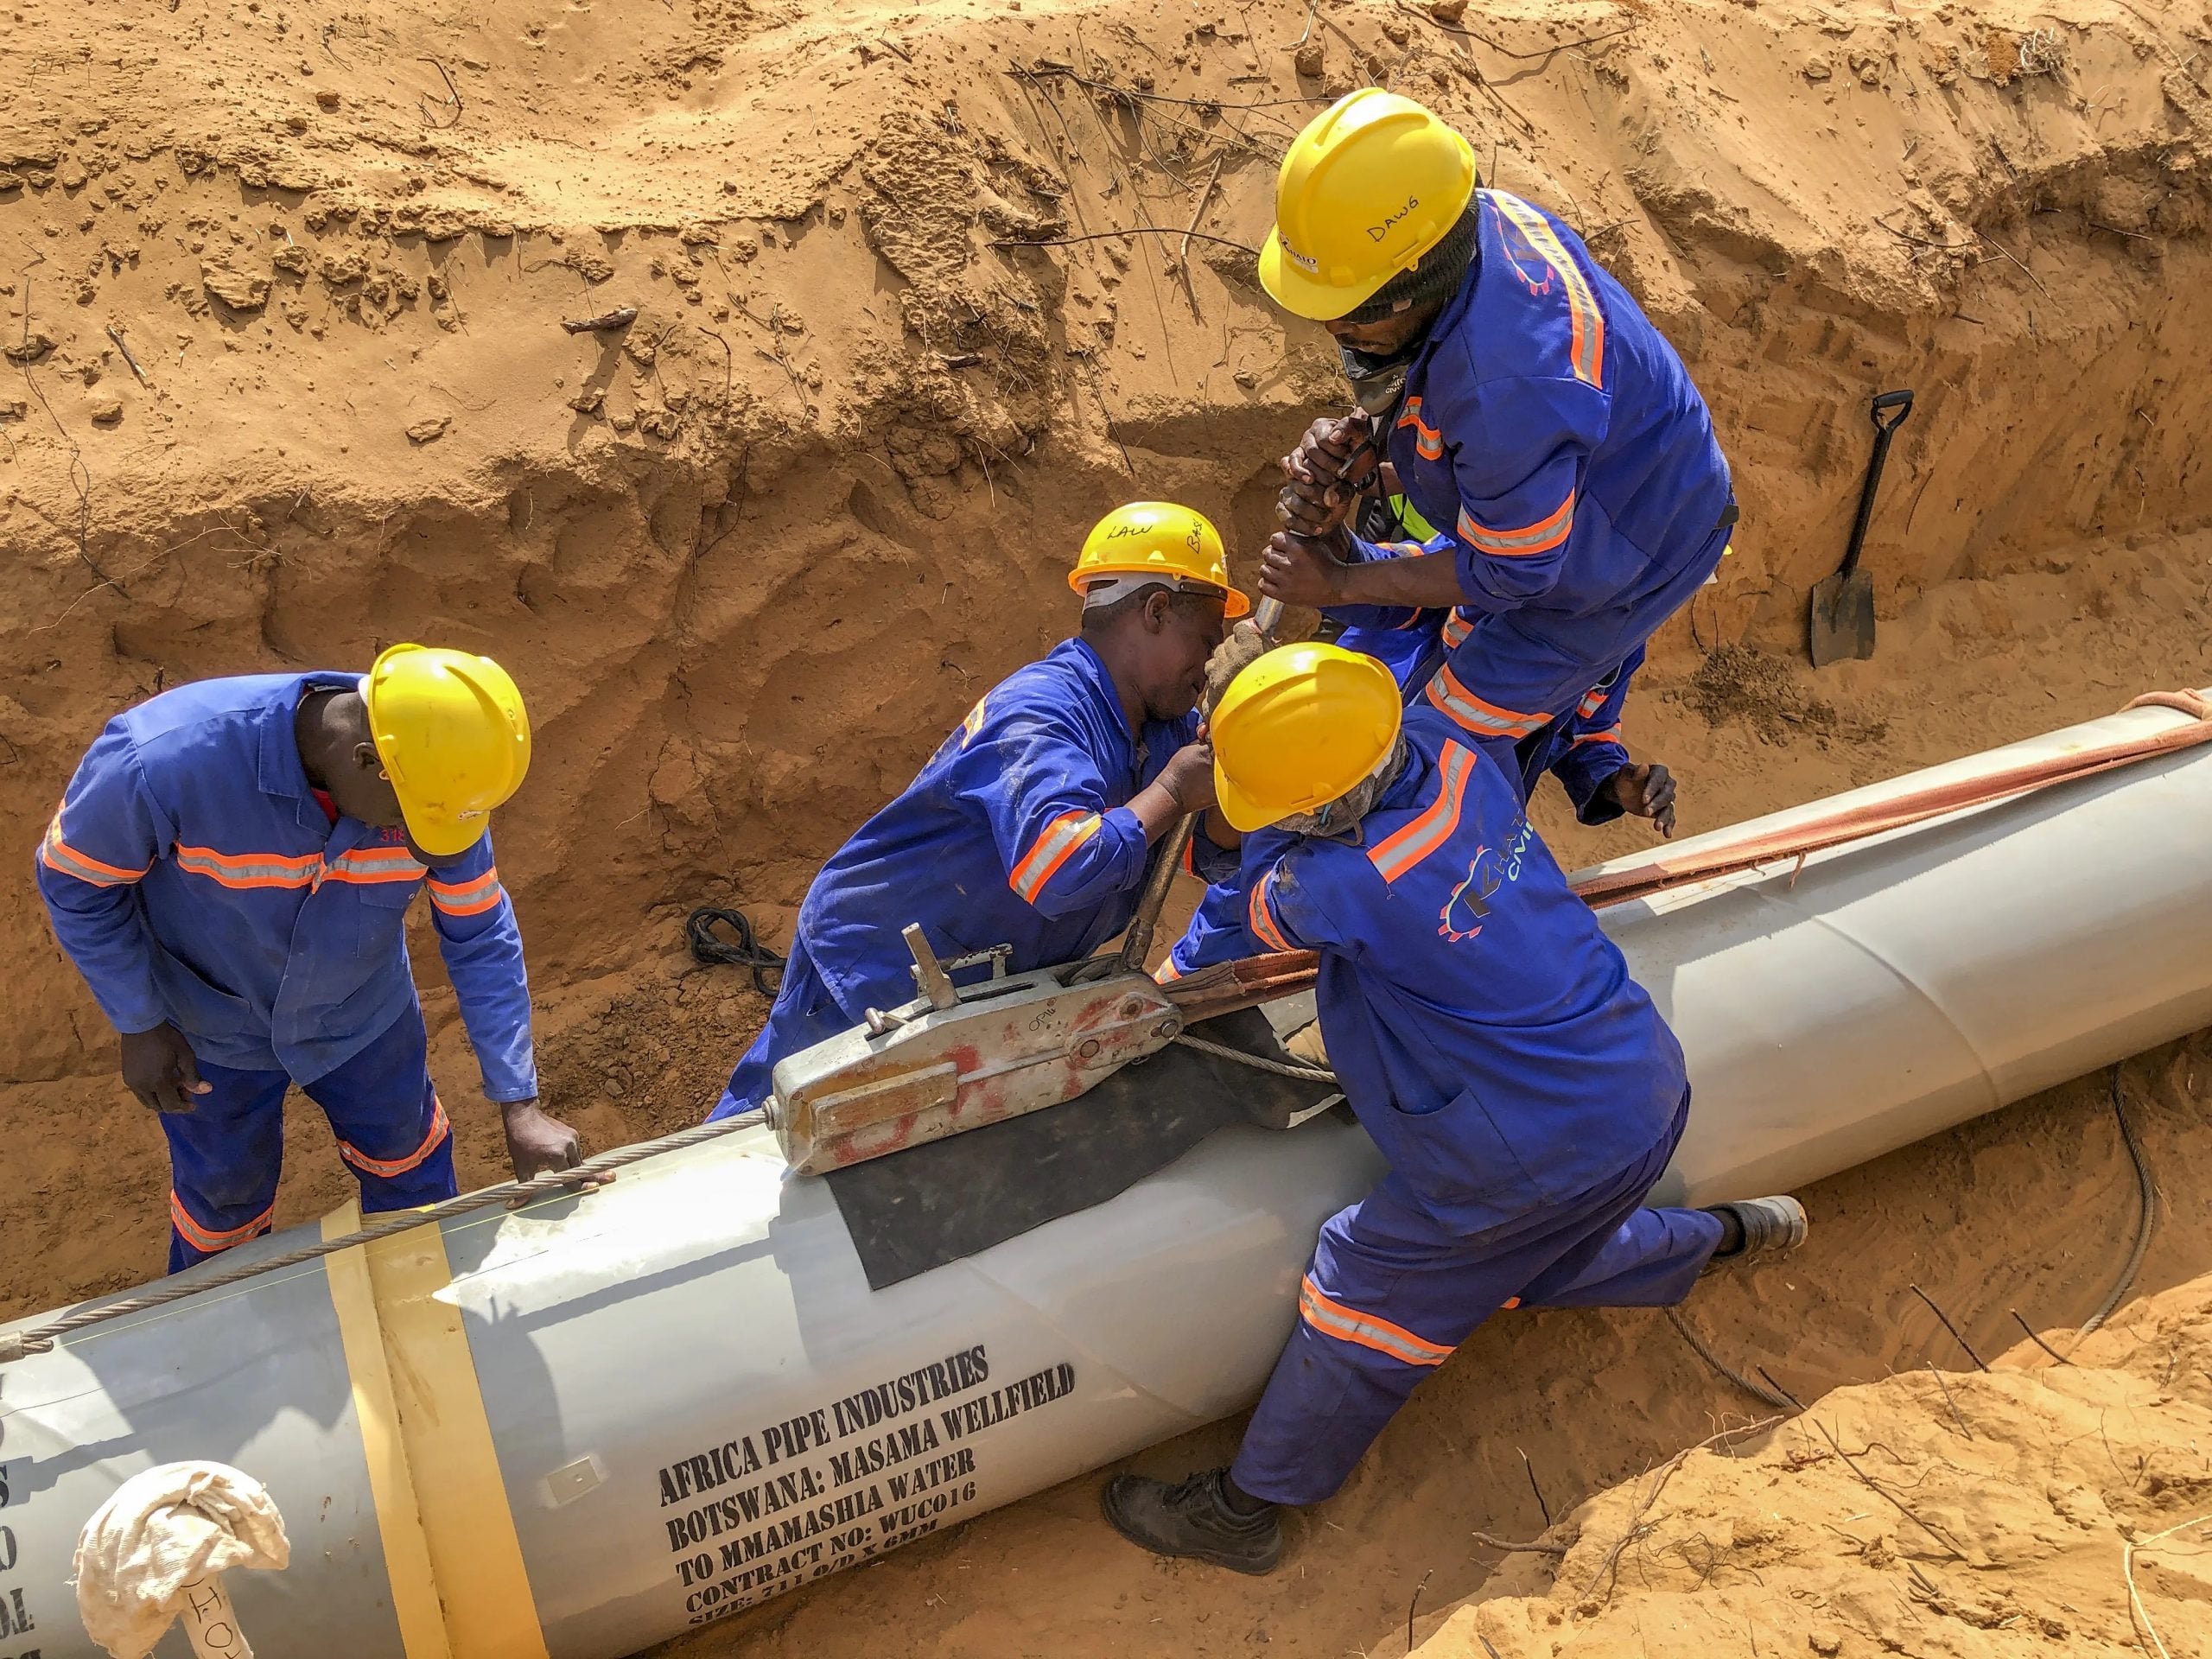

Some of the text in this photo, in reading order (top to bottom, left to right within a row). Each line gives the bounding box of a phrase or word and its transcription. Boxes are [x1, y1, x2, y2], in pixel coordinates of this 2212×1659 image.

[659, 1344, 989, 1508] AFRICA PIPE INDUSTRIES
[665, 1363, 1076, 1552] BOTSWANA: MASAMA WELLFIELD
[676, 1447, 976, 1587] TO MMAMASHIA WATER
[686, 1542, 823, 1613] CONTRACT
[830, 1527, 872, 1555] NO:
[689, 1596, 753, 1626] SIZE:
[762, 1574, 803, 1598] 711
[863, 1542, 879, 1558] X
[884, 1518, 938, 1549] 6MM
